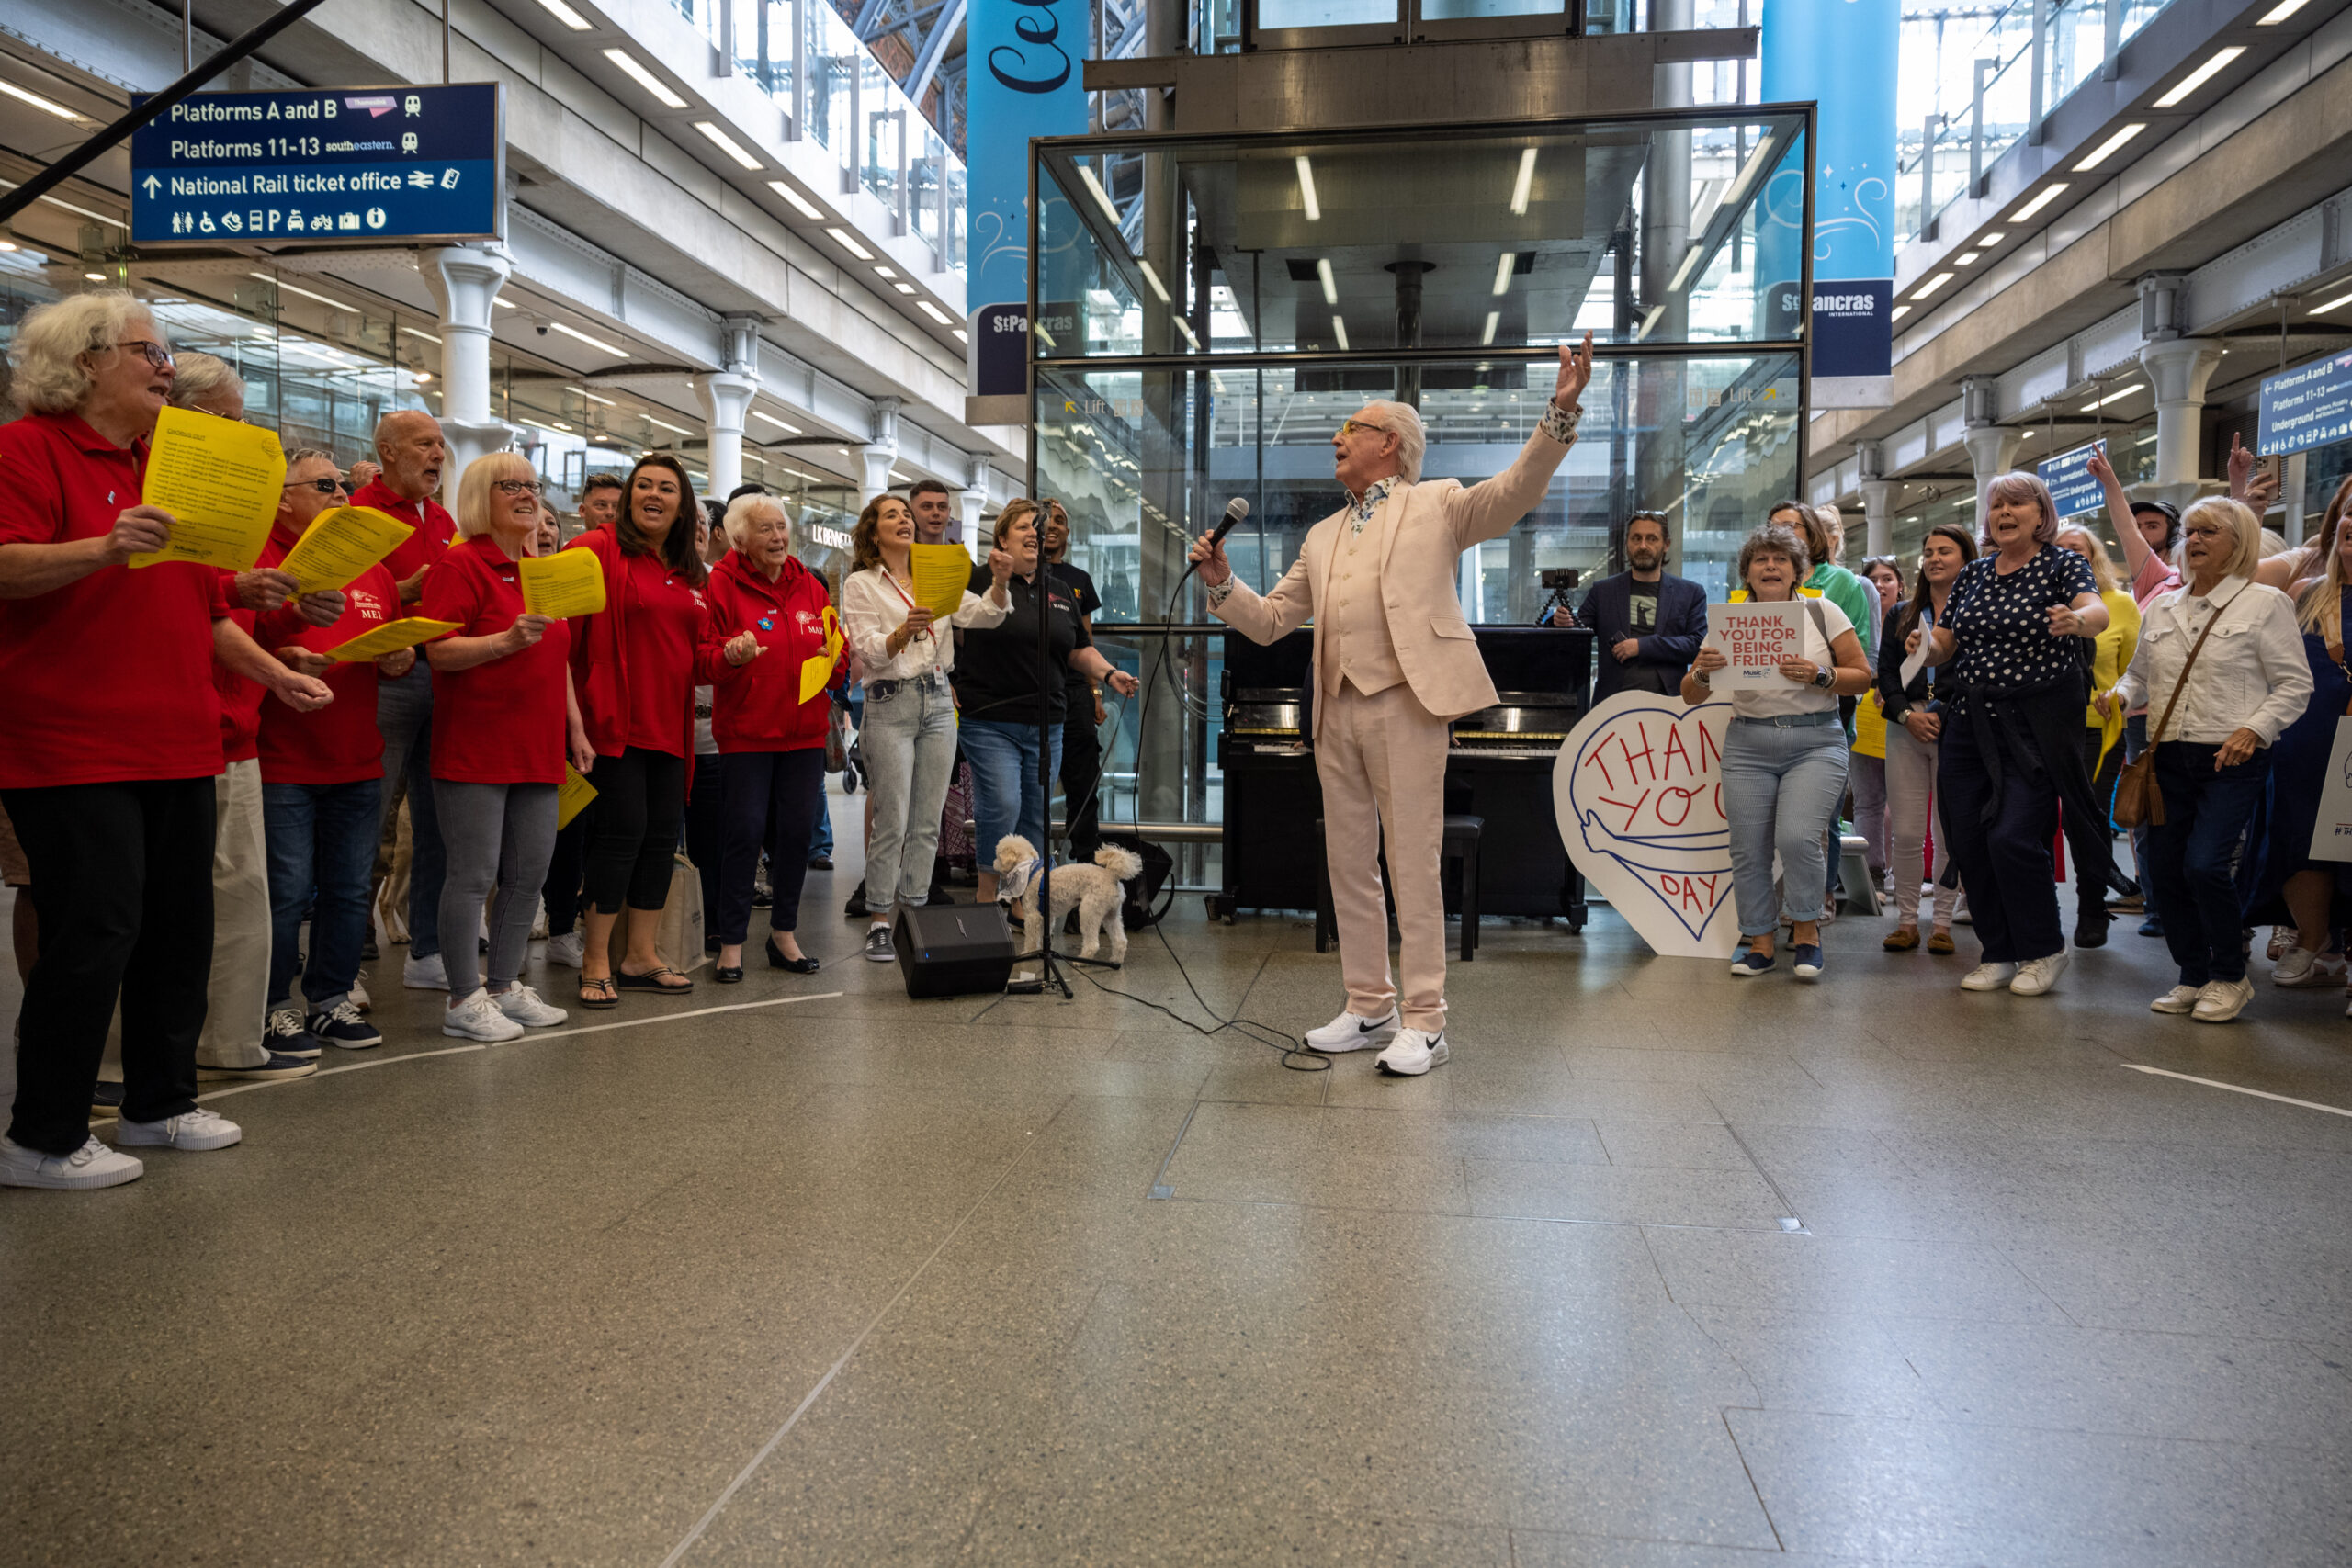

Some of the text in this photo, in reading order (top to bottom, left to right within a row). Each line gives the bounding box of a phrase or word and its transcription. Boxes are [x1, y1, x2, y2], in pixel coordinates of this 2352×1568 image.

[989, 0, 1069, 93] Ce
[171, 99, 337, 122] Platforms A and B
[171, 140, 263, 159] Platforms
[268, 137, 320, 156] 11-13
[171, 172, 401, 196] National Rail ticket office
[268, 209, 281, 231] P
[2274, 362, 2333, 392] Platforms A and B
[1085, 399, 1106, 413] Lift
[1730, 387, 1753, 402] Lift
[2272, 395, 2304, 412] Platforms
[2306, 385, 2325, 400] 11-13
[2272, 410, 2314, 433] Underground
[1725, 615, 1784, 628] THANK
[1719, 628, 1796, 641] YOU FOR
[1733, 641, 1782, 653] BEING
[1585, 720, 1724, 791] THAN
[1660, 874, 1717, 914] DAY
